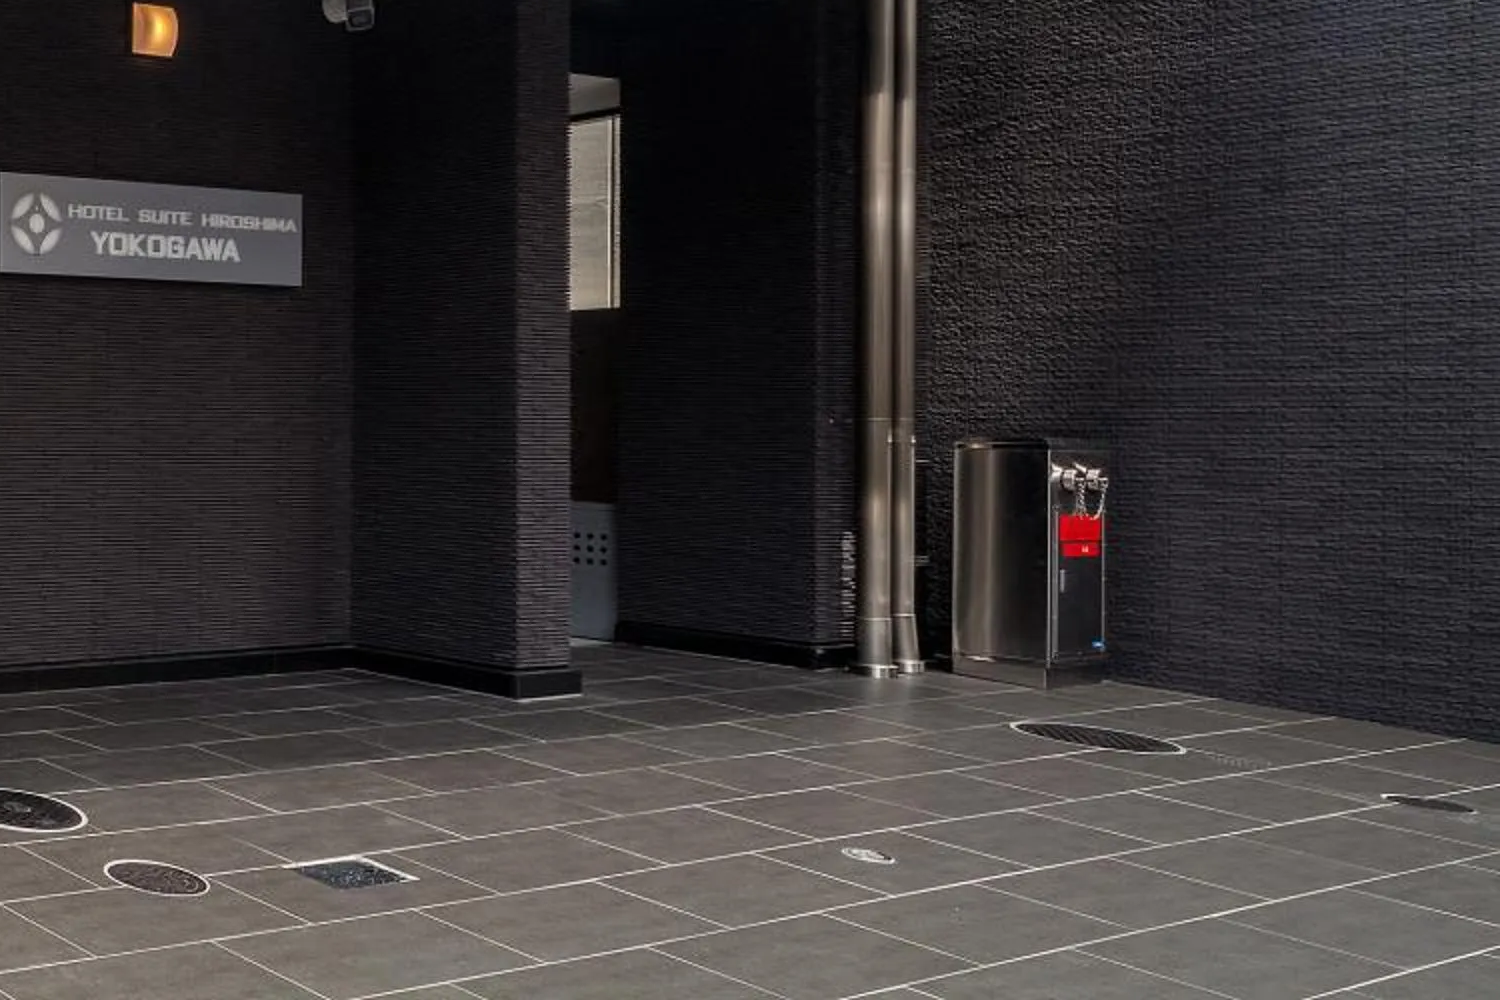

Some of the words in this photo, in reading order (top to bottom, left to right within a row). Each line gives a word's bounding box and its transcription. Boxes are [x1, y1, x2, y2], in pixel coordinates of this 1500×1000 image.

[68, 203, 128, 222] HOTEL
[139, 209, 193, 226] SUITE
[202, 213, 297, 232] HIROSHIMA
[90, 230, 241, 262] YOKOGAWA
